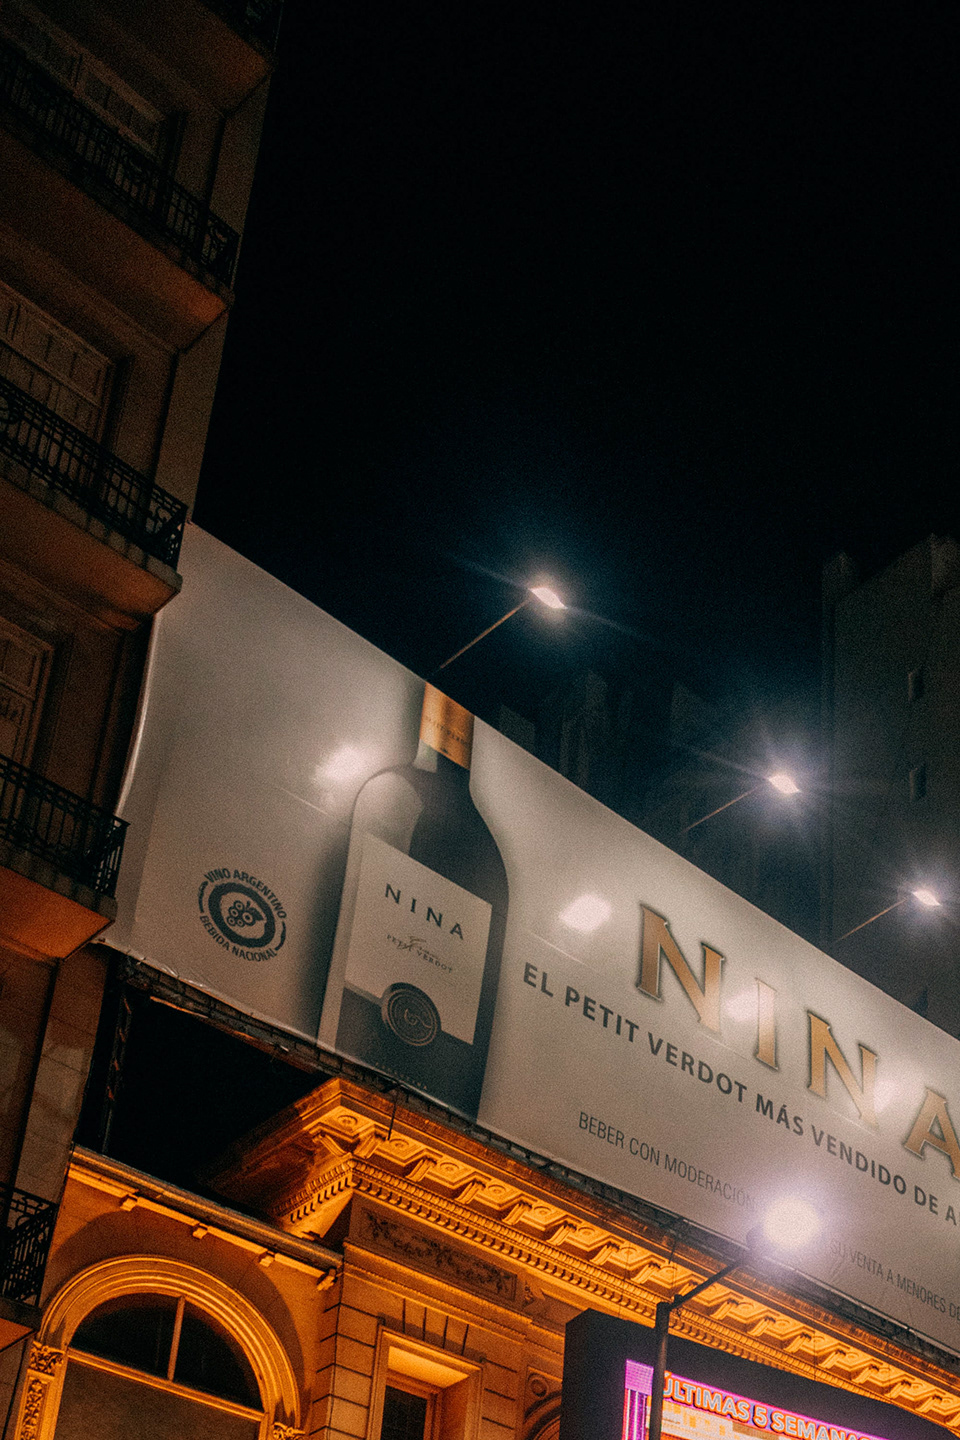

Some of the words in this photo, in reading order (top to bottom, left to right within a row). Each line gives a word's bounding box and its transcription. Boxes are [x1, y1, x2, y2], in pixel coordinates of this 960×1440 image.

[204, 868, 231, 883] VINO
[233, 869, 287, 919] ARGENTINO
[385, 883, 463, 940] NINA
[200, 915, 230, 951] BEBIDA
[232, 945, 277, 962] NACIONAL
[523, 961, 553, 997] EL
[564, 986, 639, 1042] PETIT
[647, 1031, 747, 1103] VERDOT
[755, 1093, 804, 1136] MÁS
[811, 1124, 907, 1194] VENDIDO
[914, 1185, 939, 1215] DE
[579, 1111, 624, 1149] BEBER
[629, 1138, 660, 1166] CON
[850, 1250, 884, 1278] VENTA
[897, 1273, 946, 1313] MENORES
[753, 1405, 770, 1428] 5
